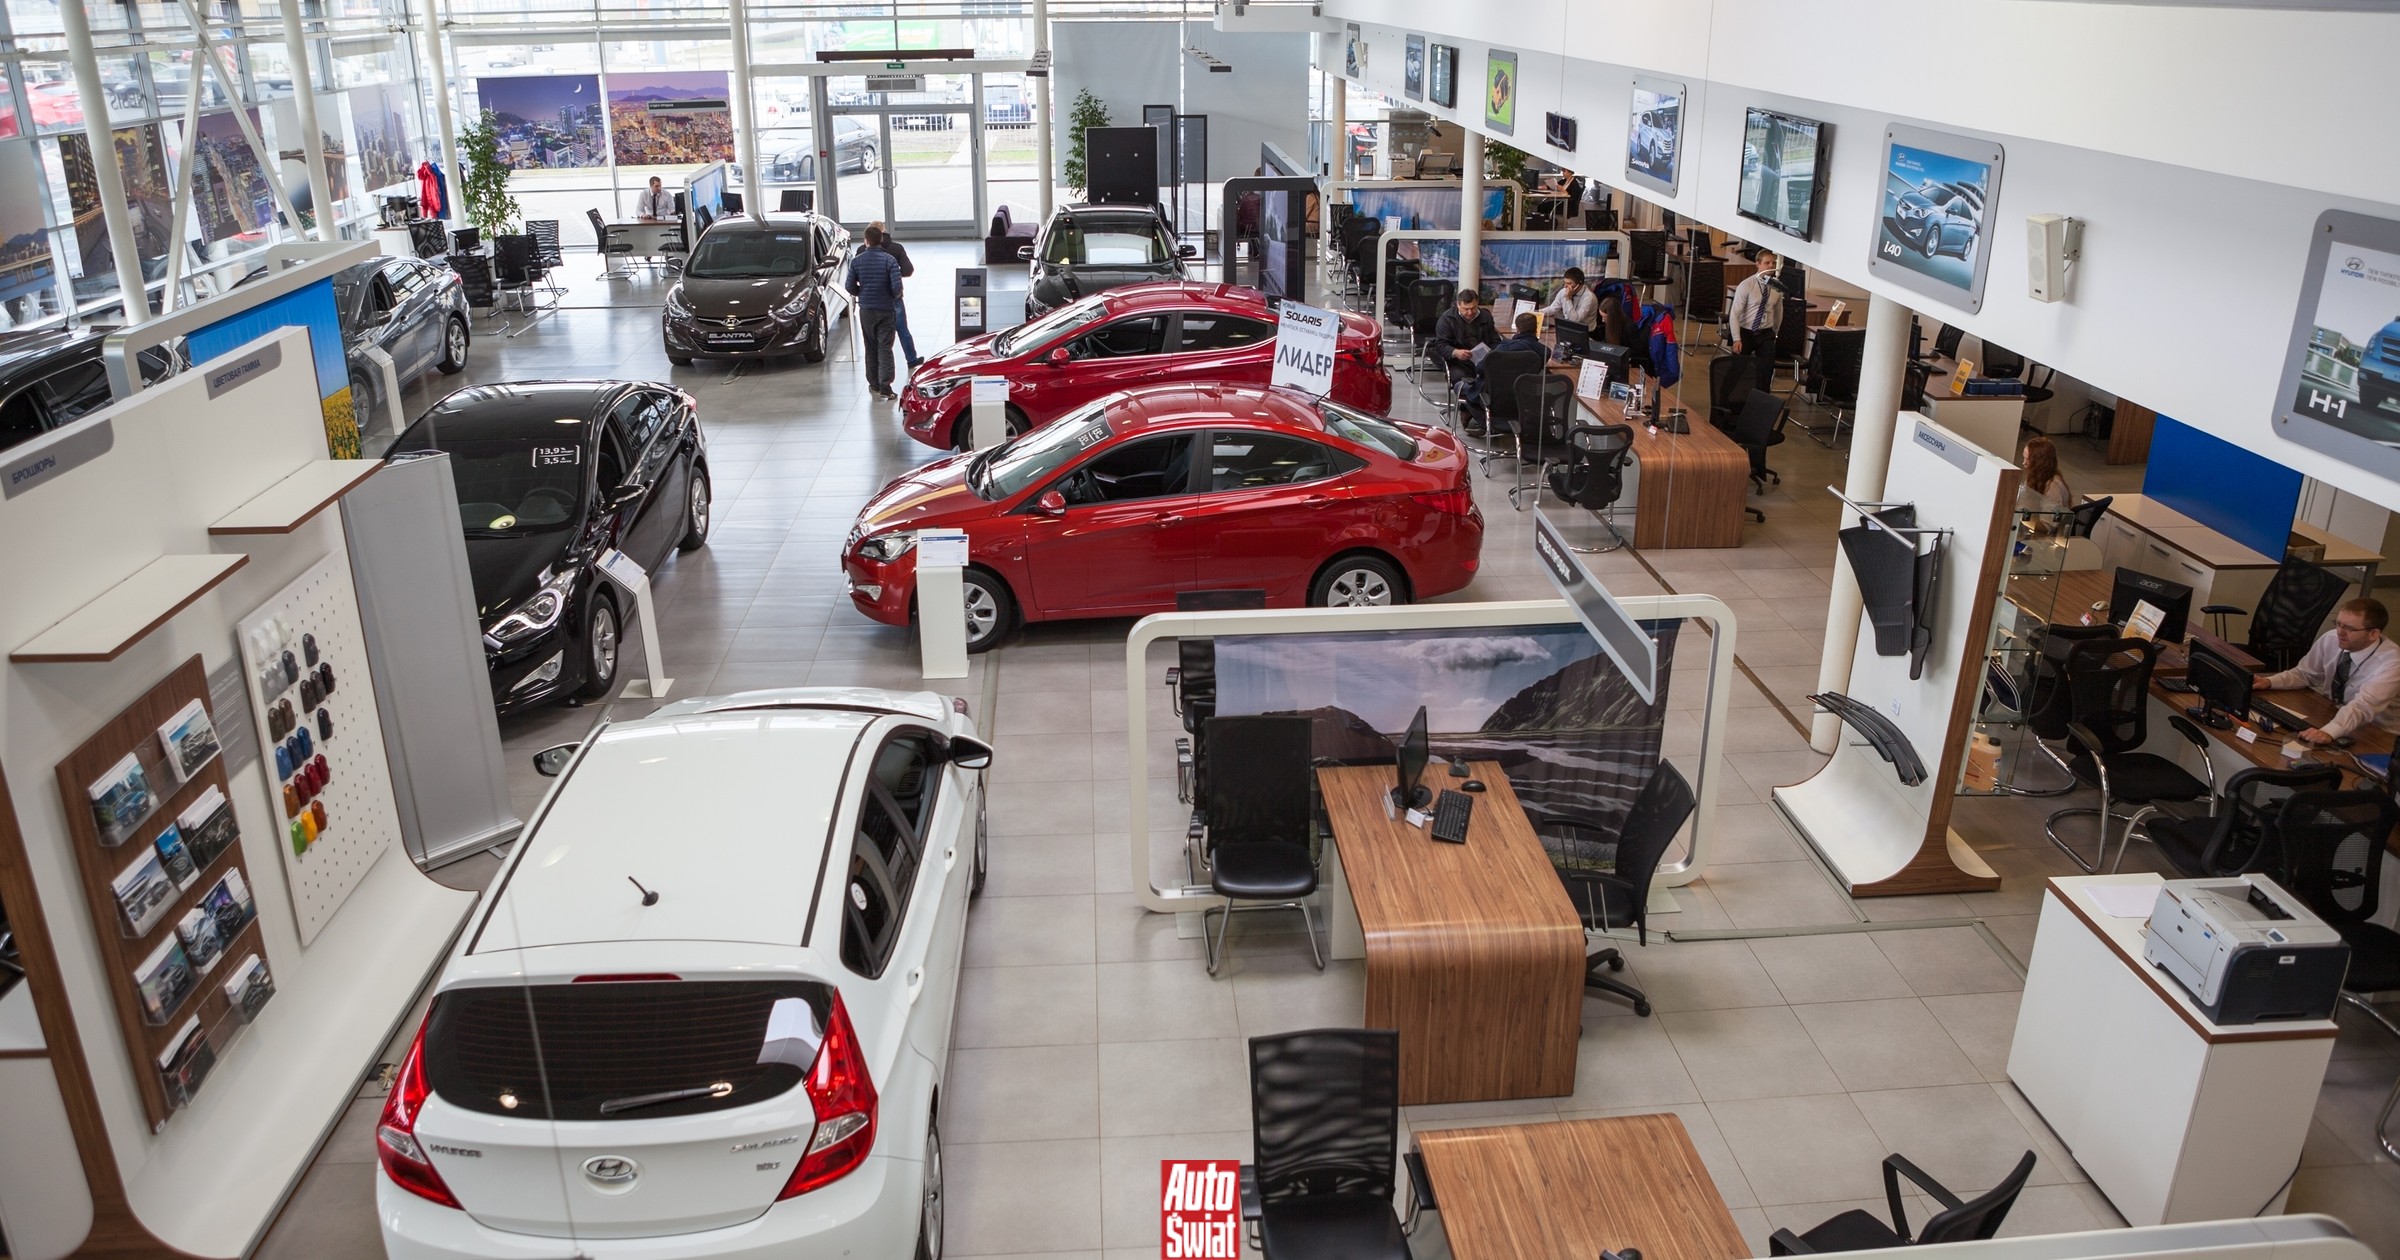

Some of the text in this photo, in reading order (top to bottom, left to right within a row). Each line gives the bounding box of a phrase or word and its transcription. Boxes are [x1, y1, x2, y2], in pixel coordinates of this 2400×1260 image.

[1284, 310, 1323, 328] SOLARIS
[213, 358, 261, 388] ЦВЕТОВАЯ ГАММА
[1276, 344, 1333, 377] ЛИДЕР
[2308, 389, 2347, 419] H-1
[1918, 430, 1946, 451] АКСЕССУАРЫ
[12, 455, 56, 484] БРОШЮРЫ
[2139, 580, 2162, 589] acer
[430, 1144, 483, 1158] HYUNDAI
